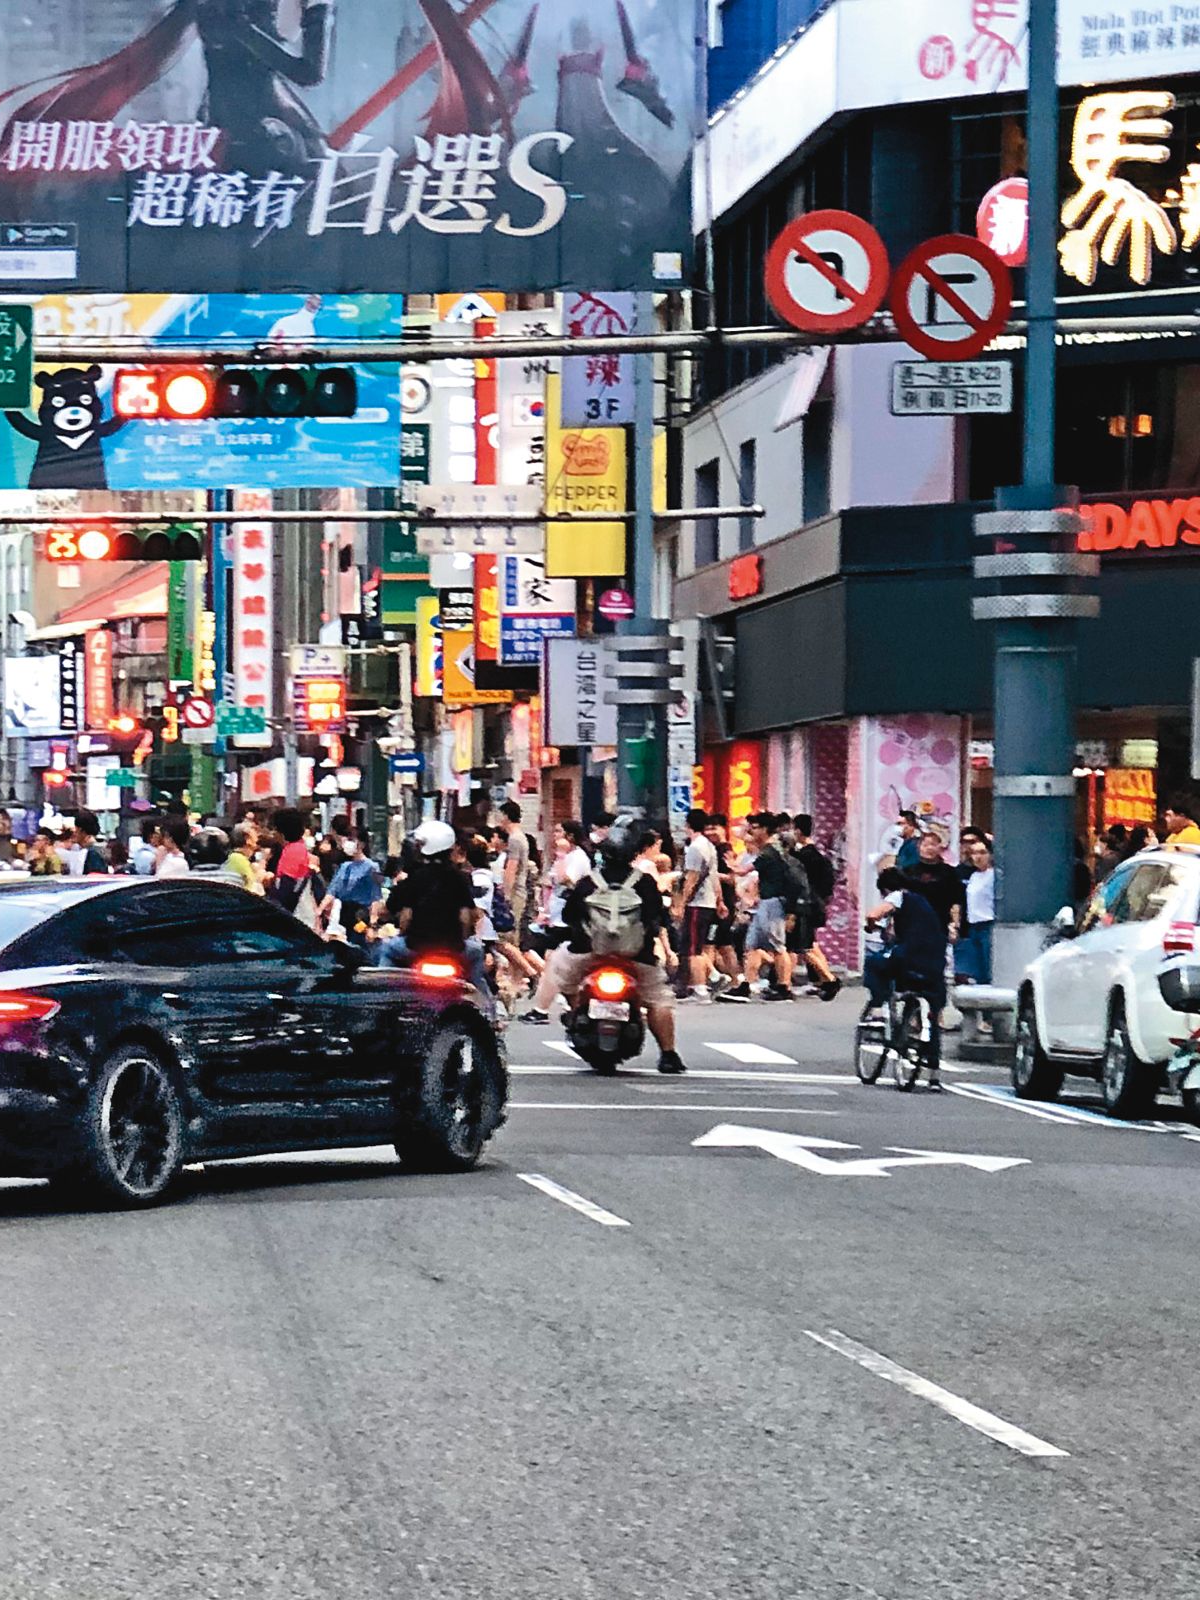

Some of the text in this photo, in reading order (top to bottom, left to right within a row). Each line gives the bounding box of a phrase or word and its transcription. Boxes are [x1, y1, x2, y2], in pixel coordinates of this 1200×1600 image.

[1131, 10, 1164, 26] Hot
[5, 120, 220, 172] 開服領取
[126, 171, 306, 230] 超稀有
[4, 347, 13, 361] 2
[586, 398, 620, 420] 3F
[554, 486, 618, 500] PEPPER
